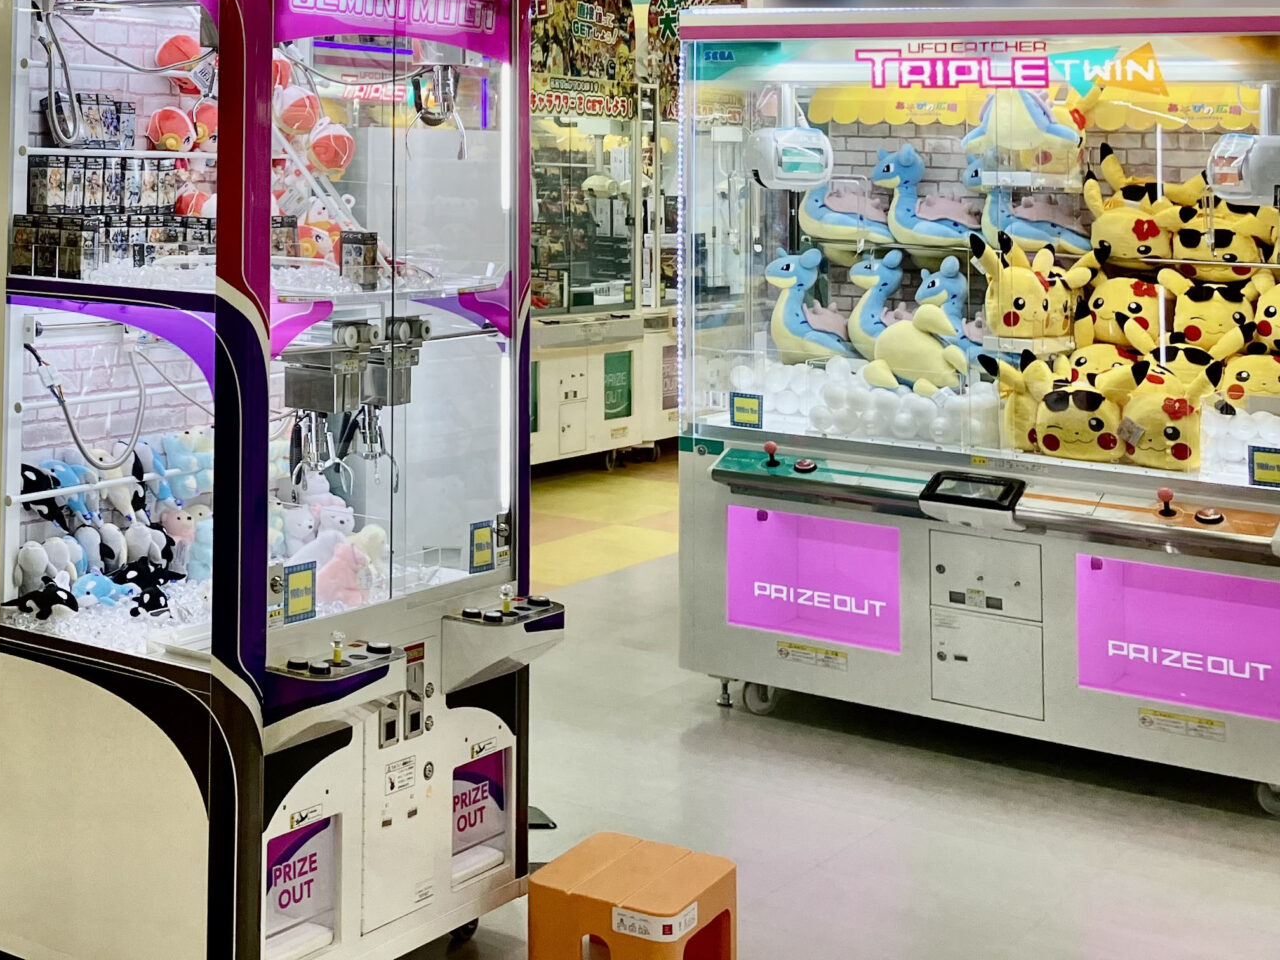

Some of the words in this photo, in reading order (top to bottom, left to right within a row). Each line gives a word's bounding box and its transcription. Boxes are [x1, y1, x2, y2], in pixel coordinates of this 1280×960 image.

[659, 12, 680, 42] 大
[704, 50, 735, 62] SEGA
[907, 42, 947, 54] UFO
[950, 40, 1047, 53] CATCHER
[855, 49, 1050, 89] TRIPLE
[1054, 58, 1155, 82] TWIN
[451, 780, 490, 813] PRIZE
[456, 805, 486, 833] OUT
[272, 851, 319, 888] PRIZE
[277, 878, 315, 909] OUT
